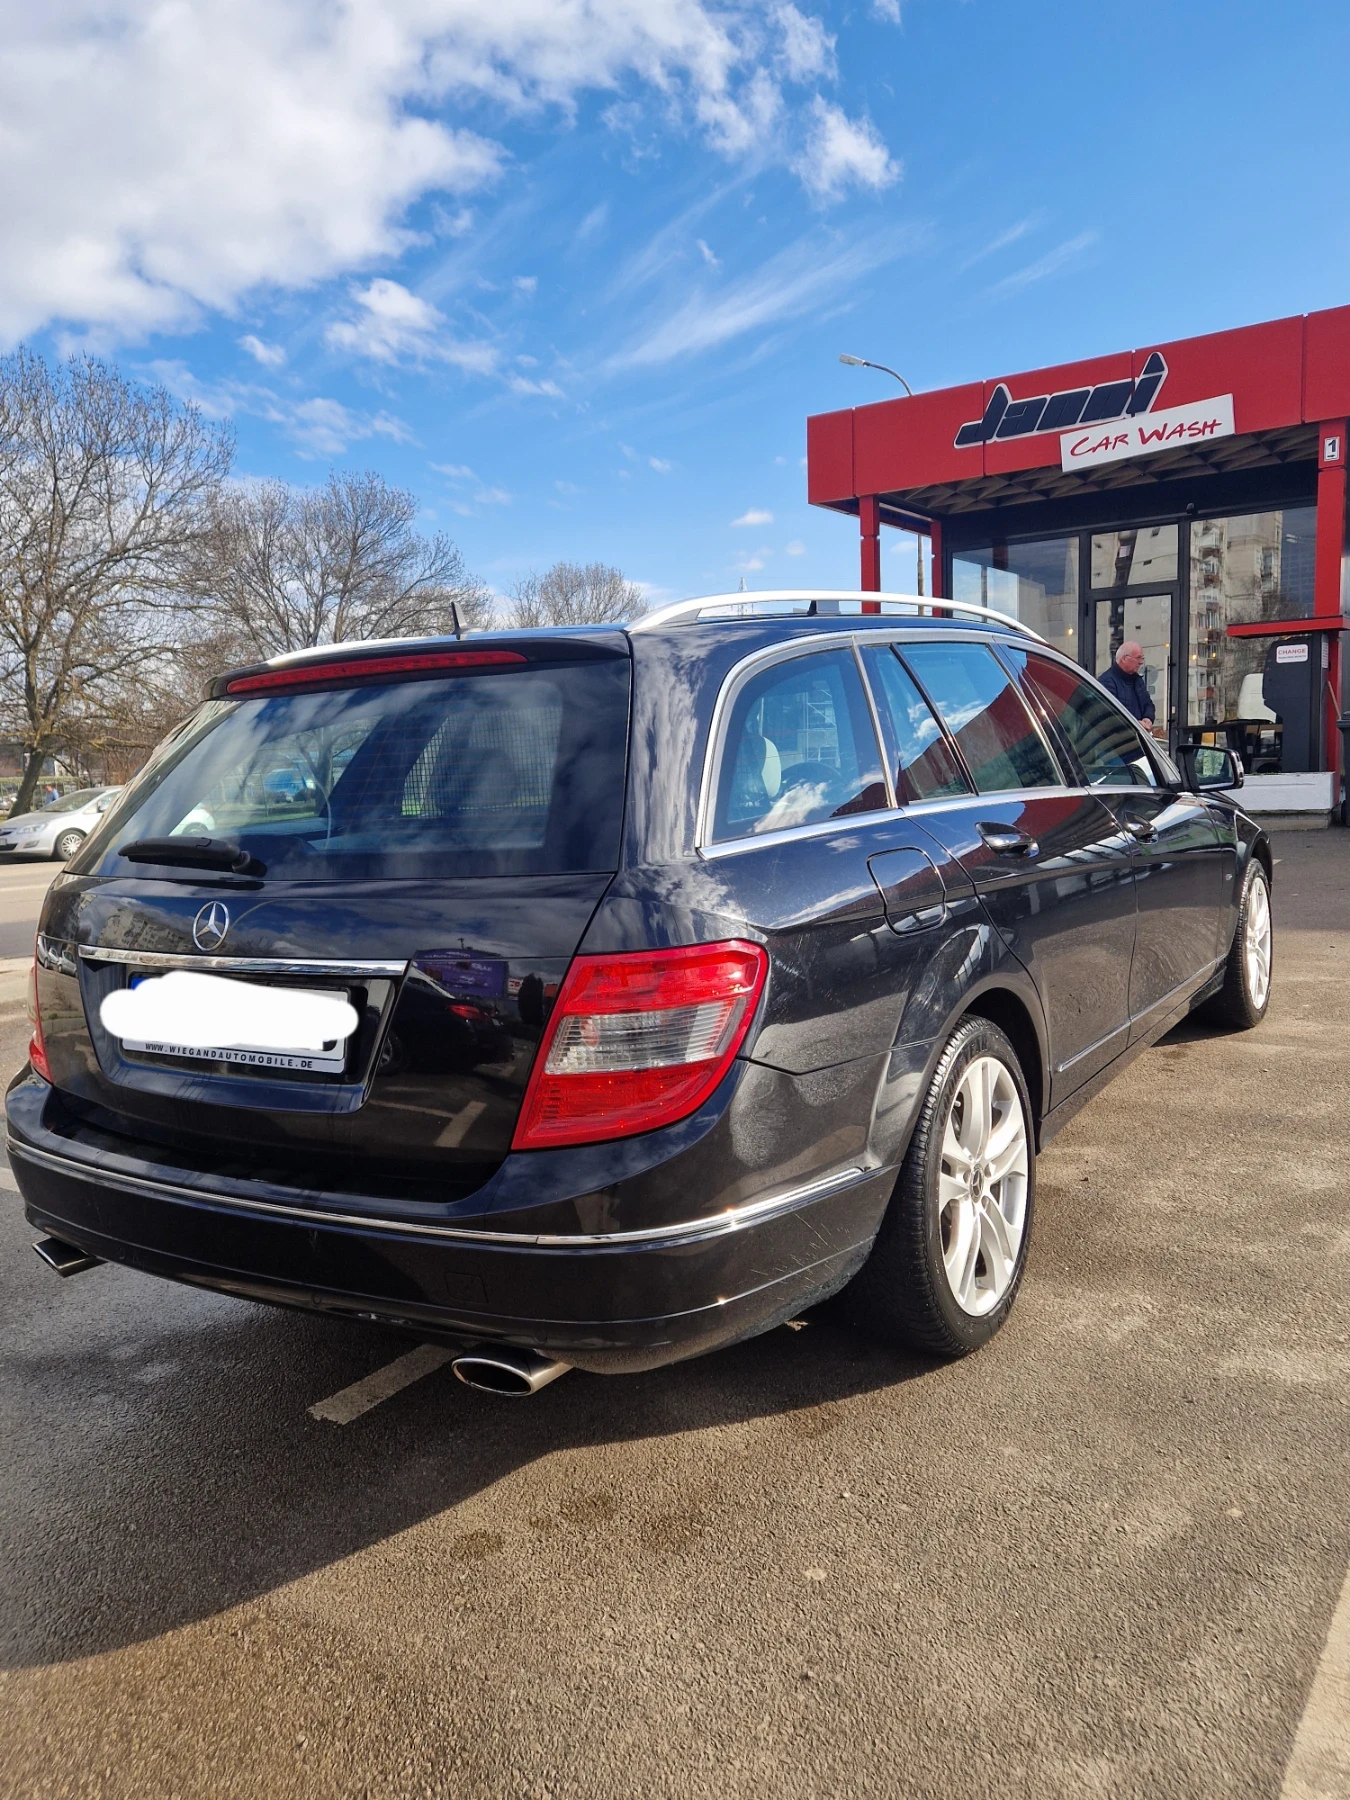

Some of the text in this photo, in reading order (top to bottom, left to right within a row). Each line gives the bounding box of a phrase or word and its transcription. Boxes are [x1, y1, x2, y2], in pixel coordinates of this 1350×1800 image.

[954, 352, 1168, 448] Janni
[1070, 418, 1223, 457] CAR WASH
[1328, 439, 1336, 453] 1
[1278, 647, 1307, 655] CHANGE
[145, 1042, 313, 1069] WWW.WIEGANDAUTOMOBILE.DE
